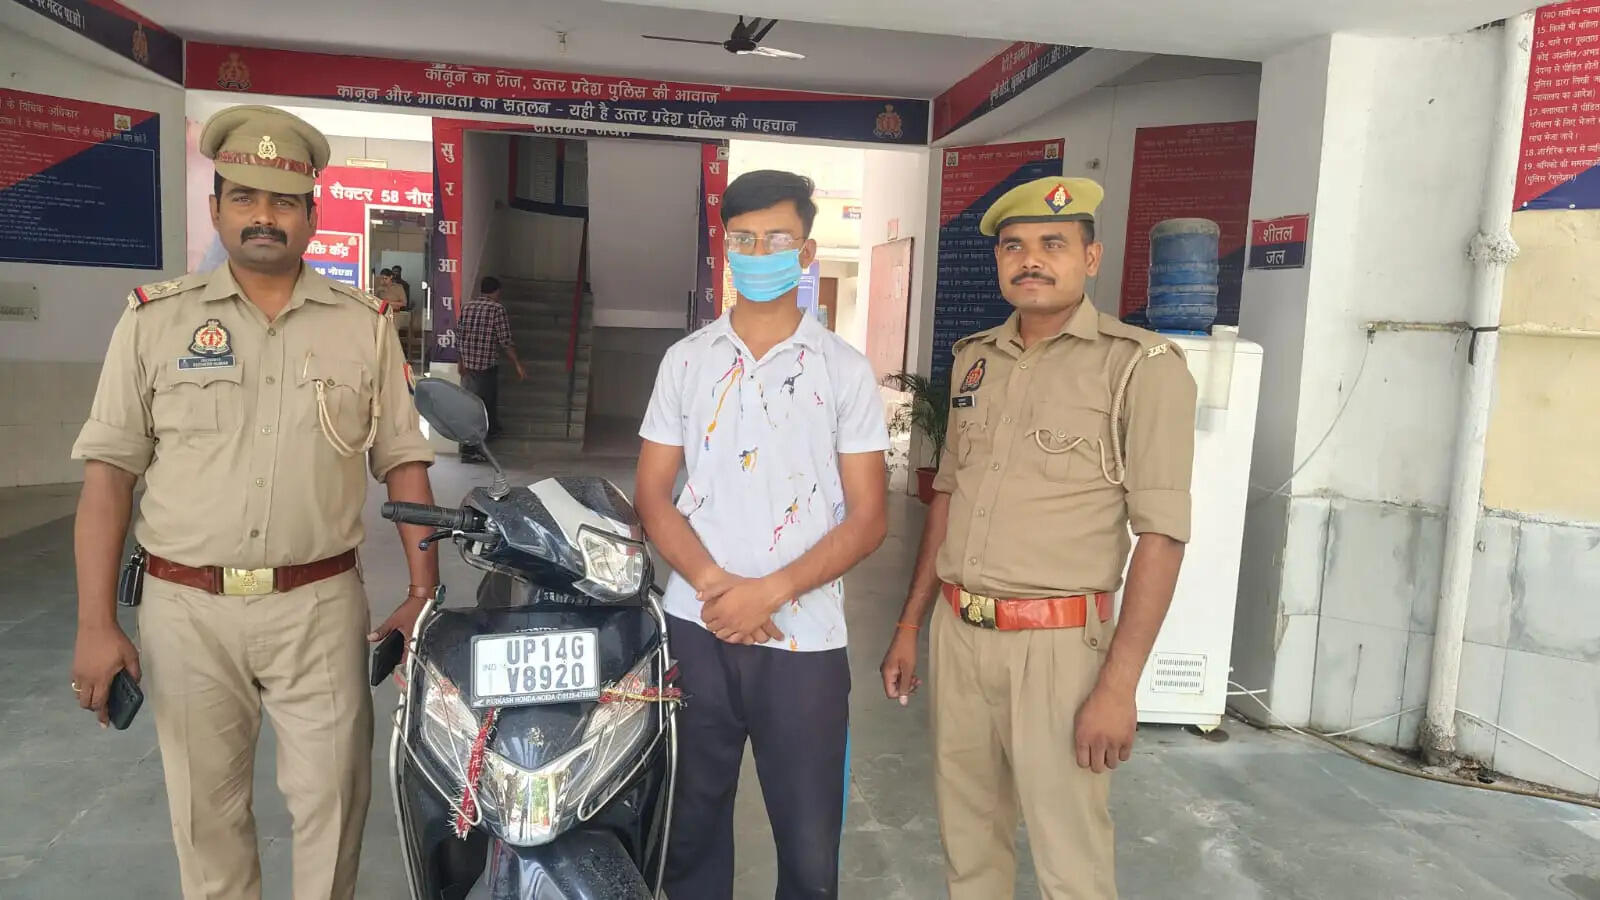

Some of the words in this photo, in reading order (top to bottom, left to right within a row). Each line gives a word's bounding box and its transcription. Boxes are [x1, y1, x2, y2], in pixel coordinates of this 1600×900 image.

[424, 67, 468, 88] कानून
[472, 70, 491, 86] का
[532, 76, 567, 93] उत्तर
[571, 77, 604, 96] प्रदेश
[608, 80, 648, 101] पुलिस
[652, 83, 671, 100] की
[675, 87, 720, 105] आवाज
[336, 84, 380, 103] कानून
[385, 84, 412, 103] और
[417, 91, 473, 109] मानवता
[479, 96, 500, 110] का
[503, 93, 551, 117] संतुलन
[569, 101, 595, 118] यही
[599, 102, 610, 120] है
[614, 107, 649, 122] उत्तर
[652, 107, 684, 125] प्रदेश
[688, 111, 728, 129] पुलिस
[731, 112, 749, 129] की
[752, 118, 798, 134] पहचान
[381, 189, 400, 203] 58
[1262, 223, 1294, 244] शीतल
[1265, 249, 1286, 265] जल
[506, 635, 585, 666] UP14G
[506, 662, 586, 693] V8920
